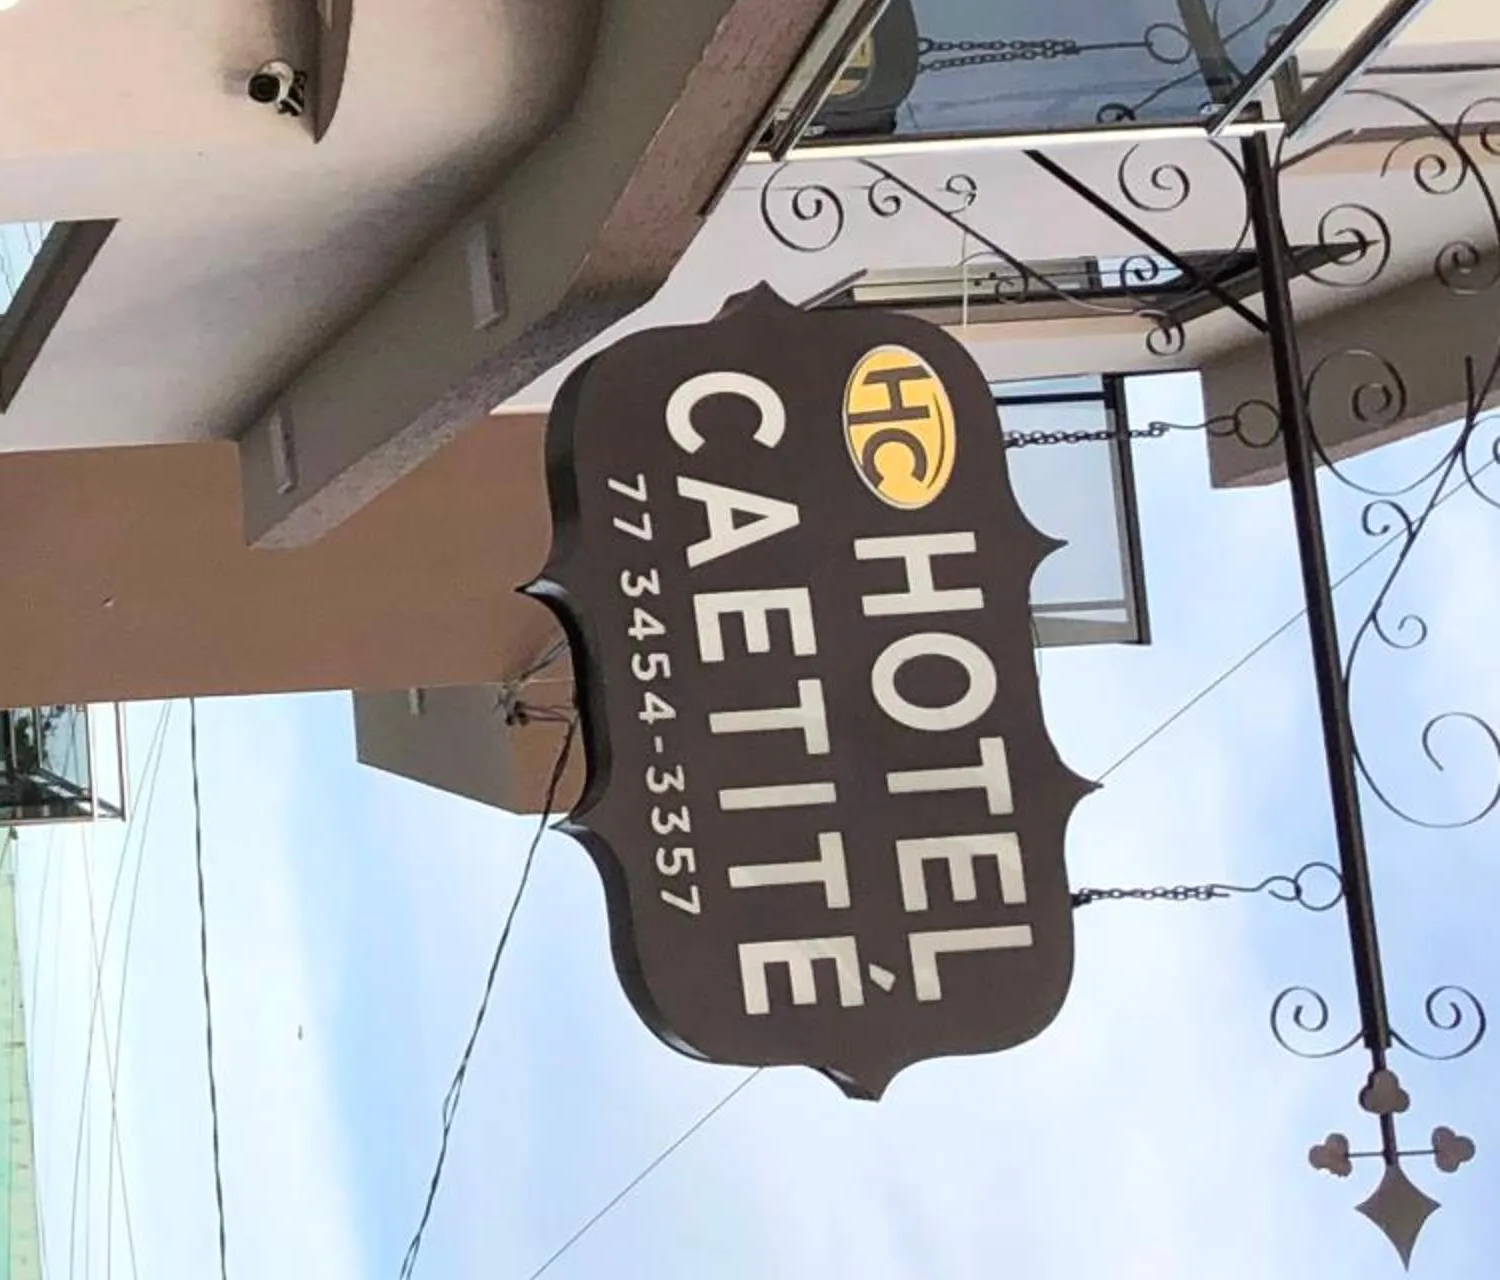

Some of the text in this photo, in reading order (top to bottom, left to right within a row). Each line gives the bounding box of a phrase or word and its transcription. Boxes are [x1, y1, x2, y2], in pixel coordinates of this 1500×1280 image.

[607, 473, 701, 916] 77 3454-3357
[665, 371, 896, 1015] CAETITÉ
[848, 365, 1033, 1001] HC HOTEL
